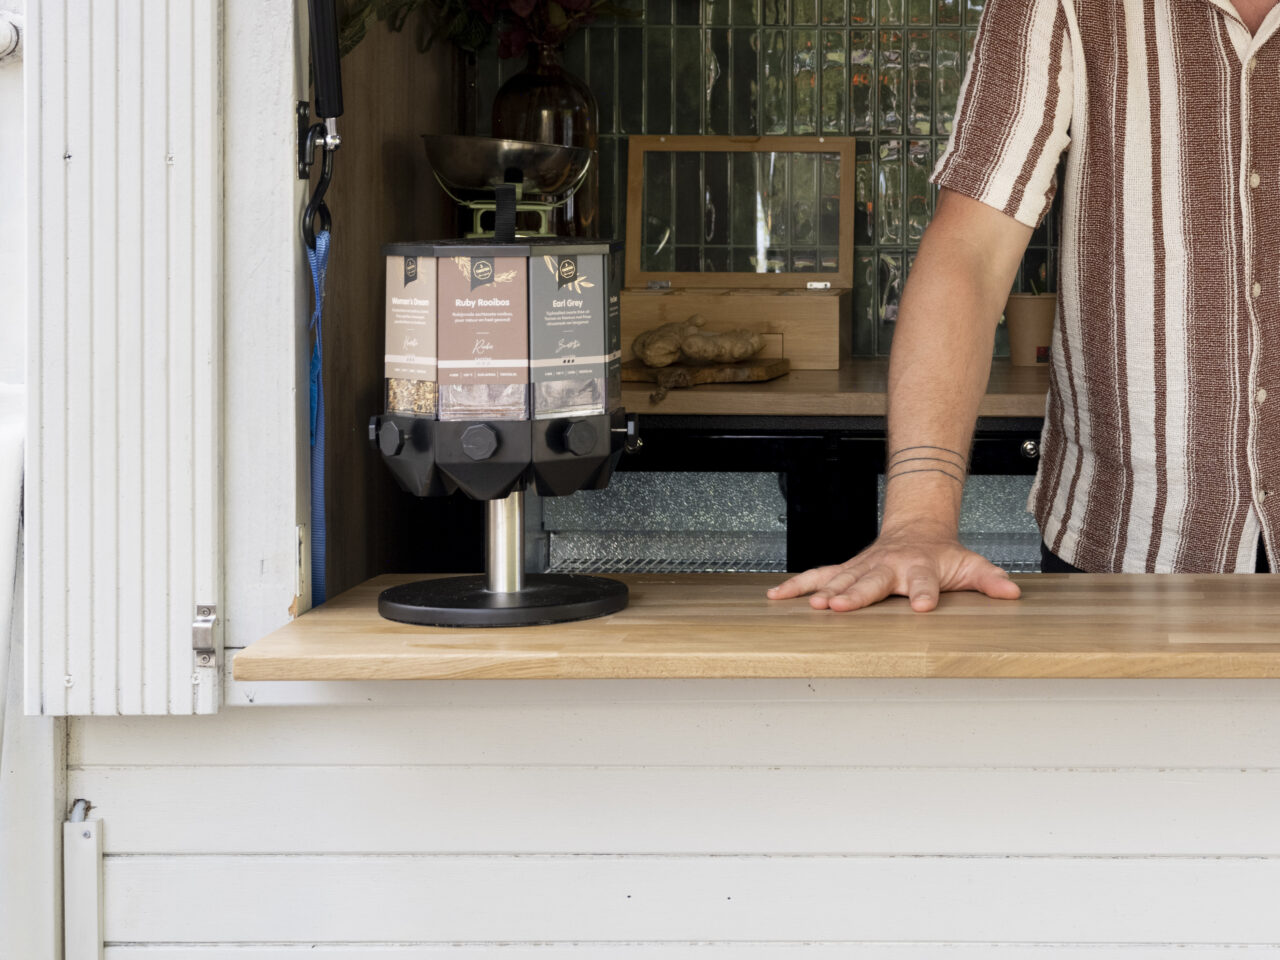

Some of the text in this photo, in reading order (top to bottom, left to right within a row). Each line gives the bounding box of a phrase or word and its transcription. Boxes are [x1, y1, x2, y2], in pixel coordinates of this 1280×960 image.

[455, 298, 510, 309] Ruby Rooibos
[552, 299, 584, 310] Earl Grey
